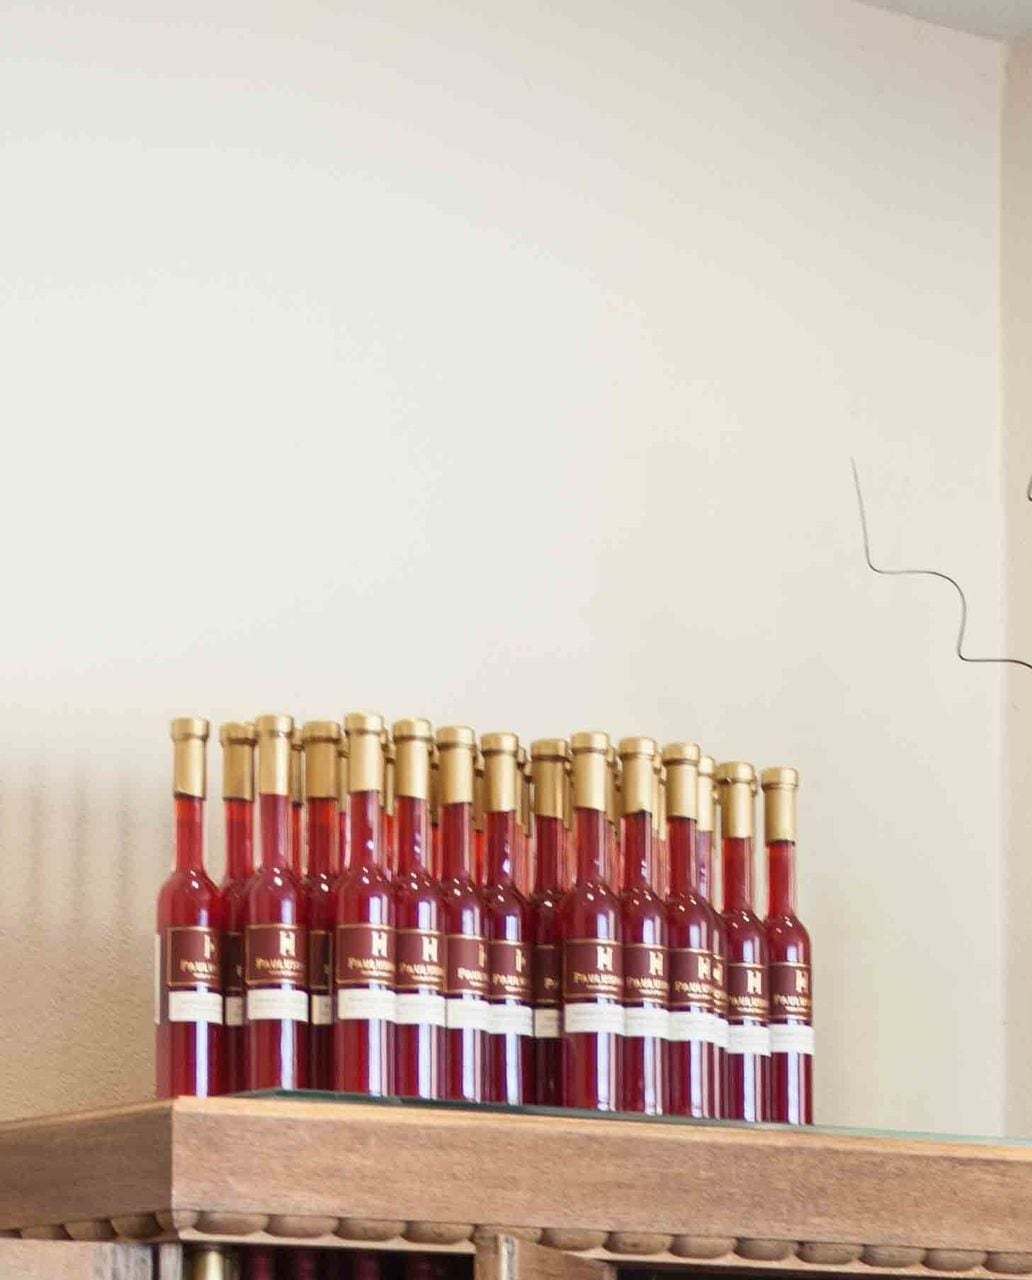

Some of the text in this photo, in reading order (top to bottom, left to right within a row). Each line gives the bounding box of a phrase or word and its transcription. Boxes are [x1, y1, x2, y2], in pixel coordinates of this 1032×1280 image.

[279, 930, 296, 957] H
[371, 930, 388, 958] H
[422, 935, 438, 962] H
[597, 945, 613, 972] H
[649, 950, 664, 977] H
[698, 955, 711, 981] H
[747, 969, 762, 995] H
[795, 969, 809, 993] H
